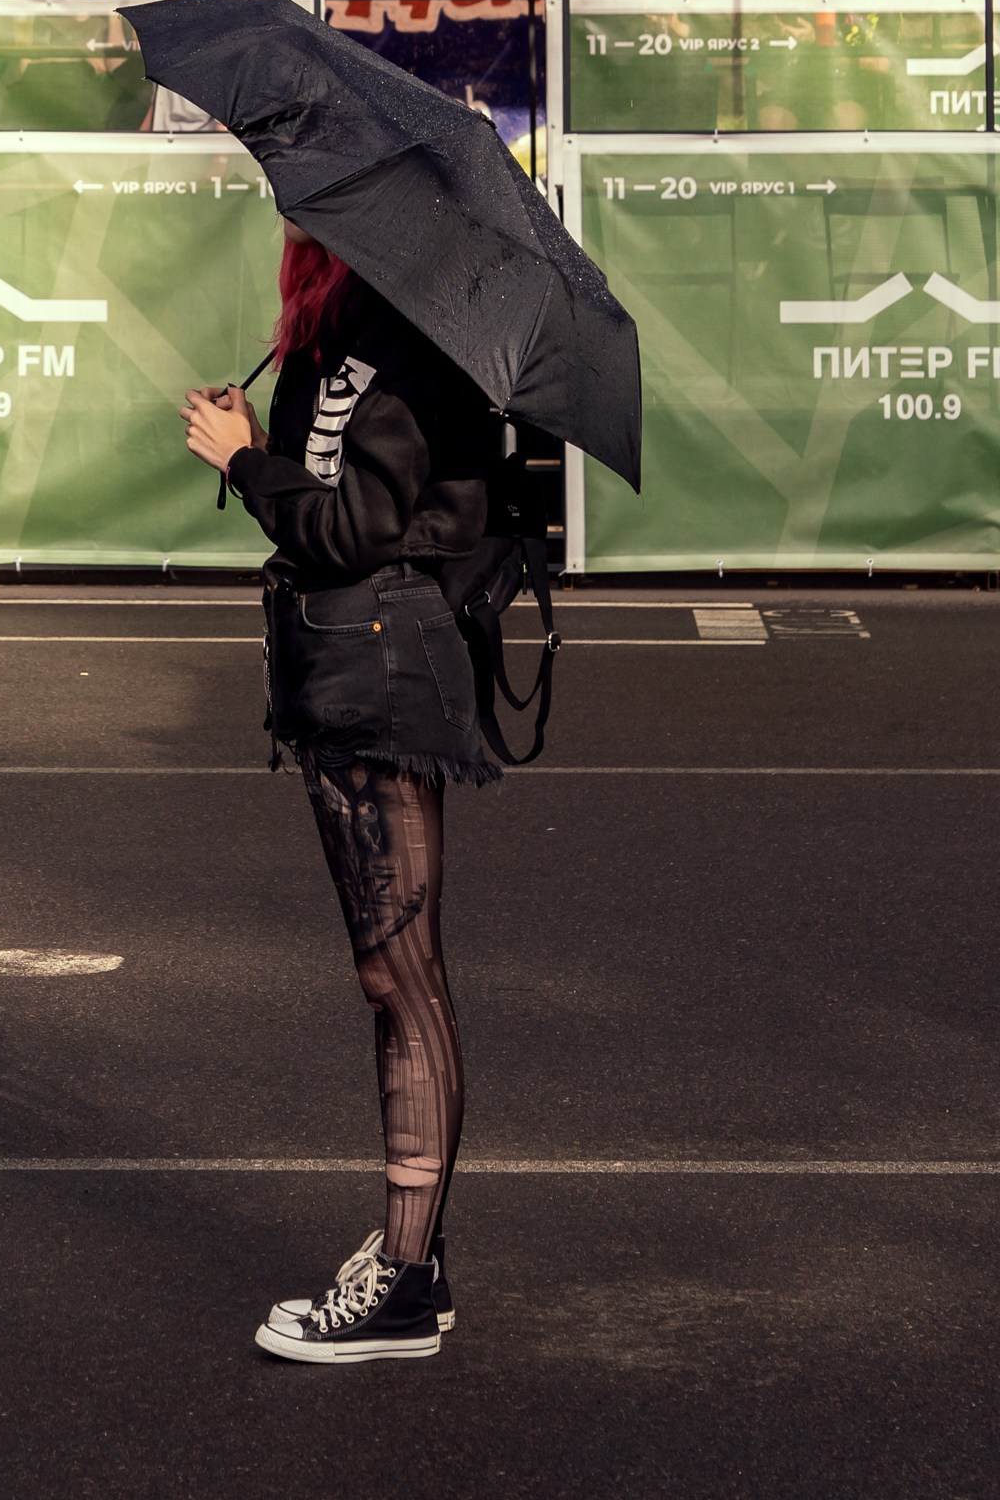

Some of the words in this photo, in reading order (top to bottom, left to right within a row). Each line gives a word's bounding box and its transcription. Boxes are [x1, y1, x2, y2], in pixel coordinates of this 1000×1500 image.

[122, 40, 140, 51] VI
[679, 38, 704, 50] VIP
[707, 38, 747, 51] ЯРУС
[750, 38, 760, 50] 2
[112, 181, 140, 194] VIP
[143, 181, 185, 195] ЯРУС
[189, 181, 197, 194] 1
[710, 181, 737, 194] VIP
[741, 181, 784, 195] ЯРУС
[788, 181, 795, 194] 1
[17, 344, 75, 377] FM
[813, 346, 953, 379] ПИТЕР
[967, 346, 1000, 379] F
[878, 393, 962, 420] 100.9
